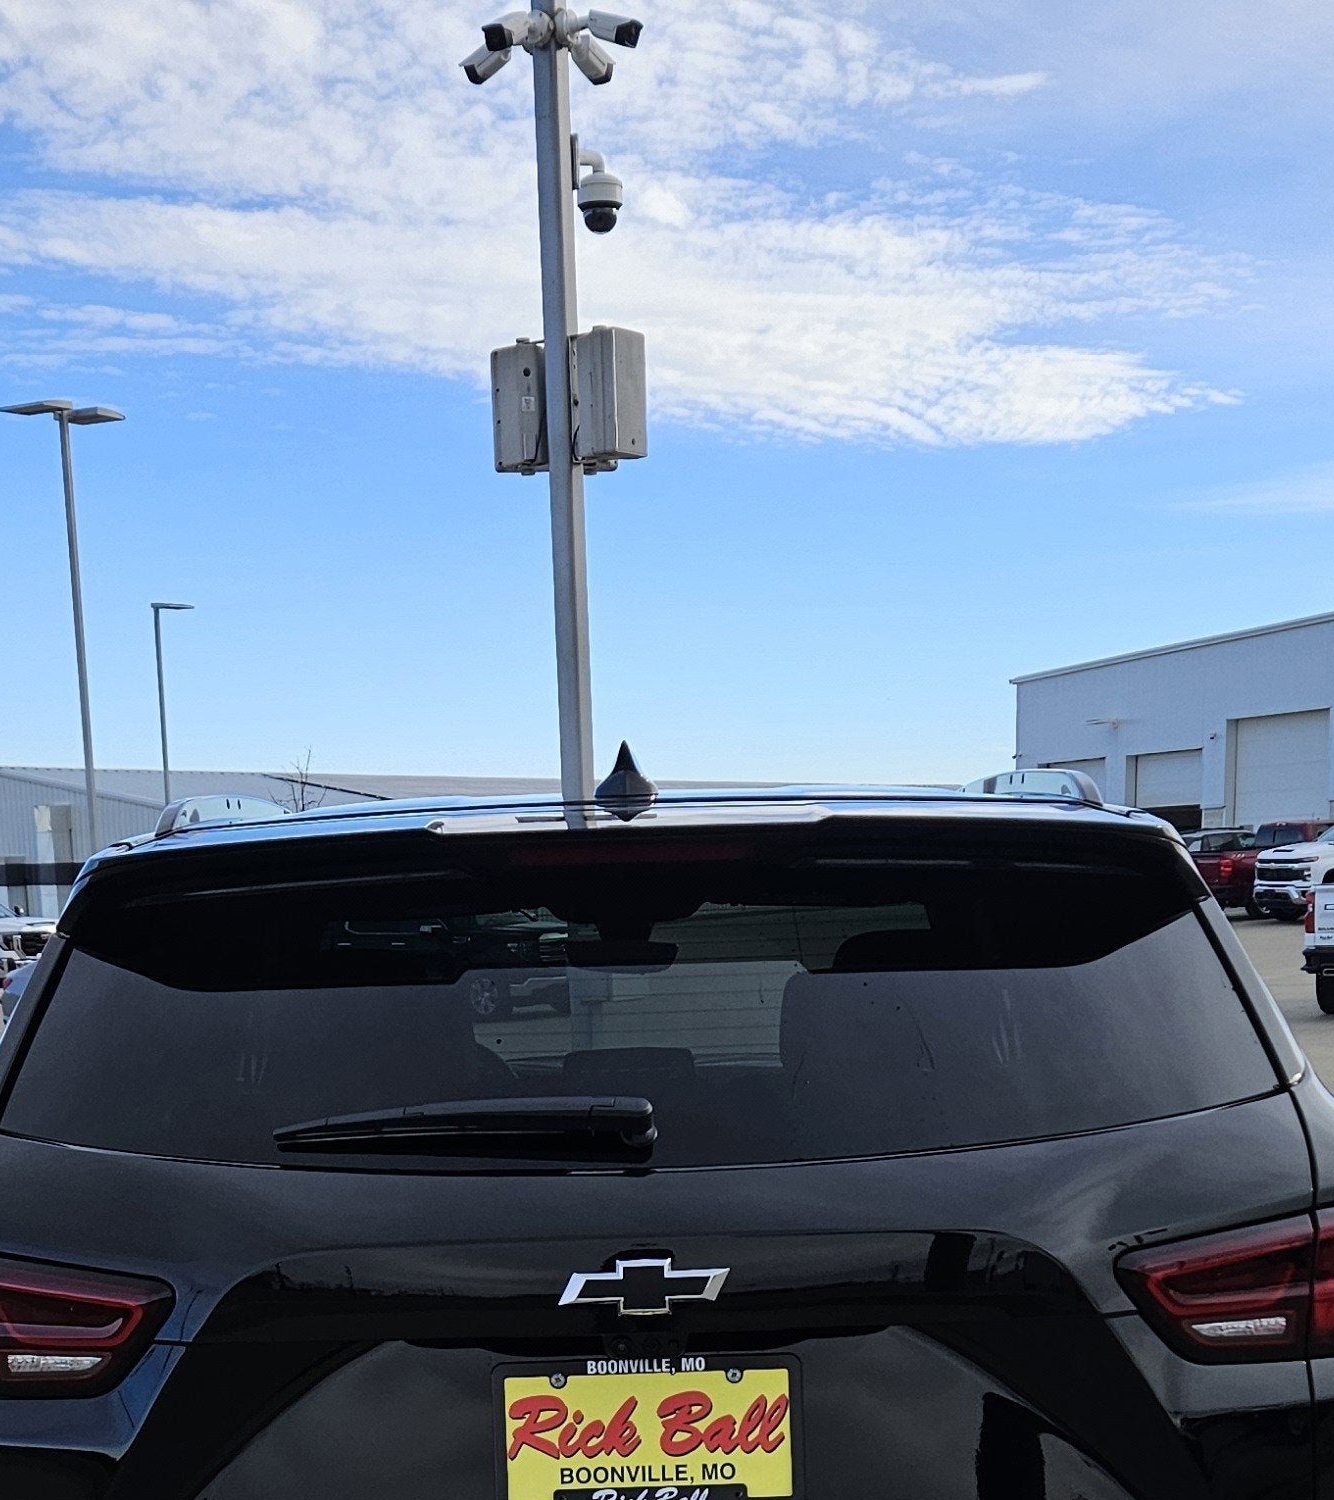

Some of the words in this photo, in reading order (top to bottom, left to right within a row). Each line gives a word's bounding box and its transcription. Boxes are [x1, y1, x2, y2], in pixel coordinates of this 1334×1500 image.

[586, 1358, 676, 1375] BOONVILLE,
[681, 1356, 706, 1372] MO
[508, 1394, 642, 1461] Rick
[656, 1390, 789, 1456] Ball
[559, 1463, 695, 1485] BOONVILLE,
[701, 1462, 737, 1481] MO
